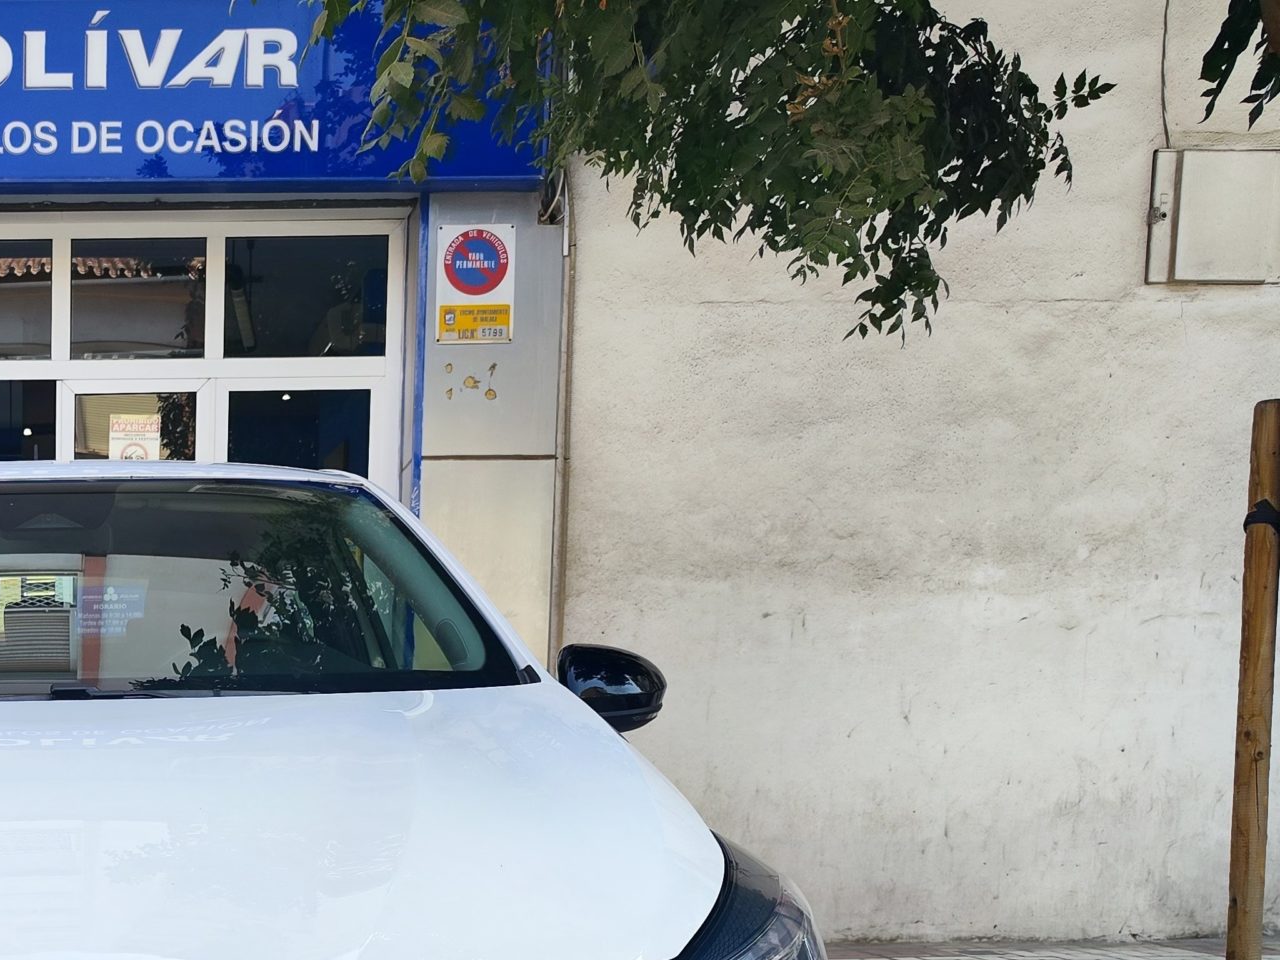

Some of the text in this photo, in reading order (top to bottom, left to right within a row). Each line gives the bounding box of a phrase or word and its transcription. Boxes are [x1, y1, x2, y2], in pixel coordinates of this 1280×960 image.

[70, 121, 122, 154] DE
[135, 111, 320, 155] OCASIÓN
[445, 235, 464, 264] ENTRADA
[455, 260, 496, 269] PERMANENTE
[112, 423, 159, 431] APARCAR
